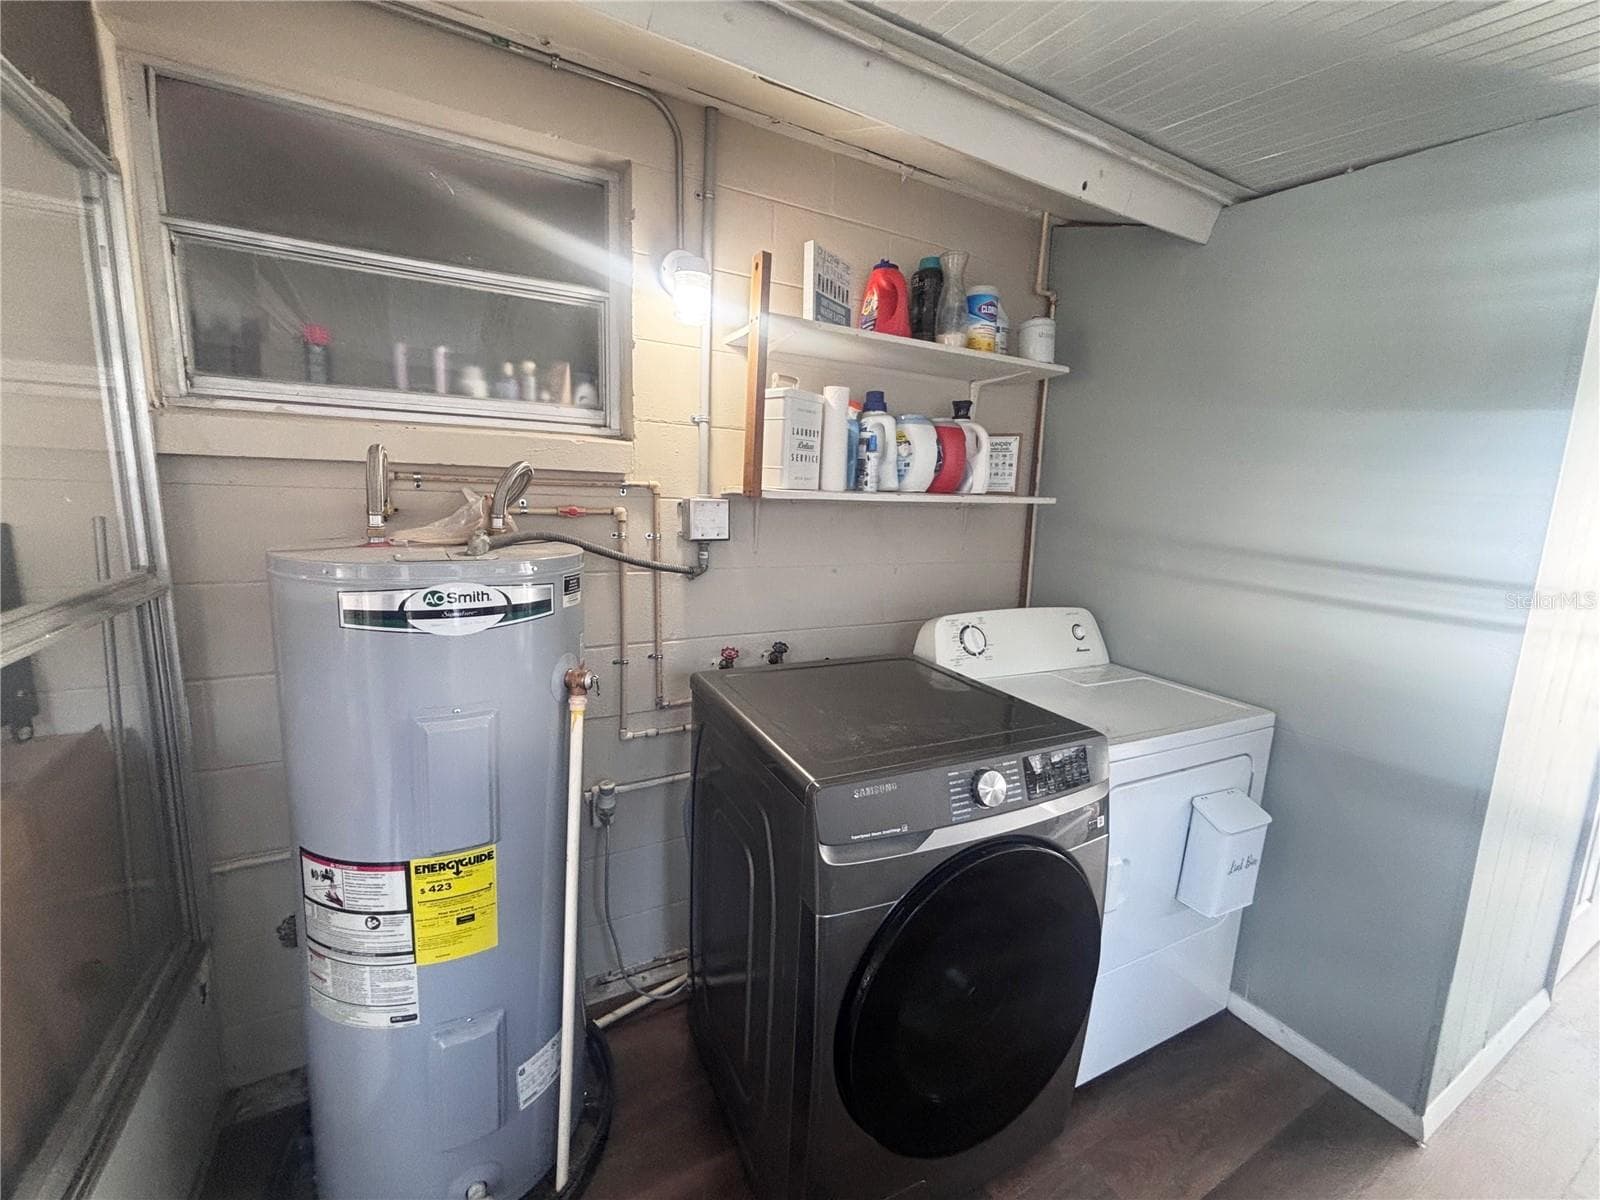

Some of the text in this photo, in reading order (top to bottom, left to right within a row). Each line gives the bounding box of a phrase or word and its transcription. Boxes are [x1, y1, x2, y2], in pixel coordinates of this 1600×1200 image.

[792, 427, 819, 437] LAUNDRY
[791, 453, 819, 463] SERVICE
[853, 783, 898, 799] SAMSUNG
[428, 882, 453, 893] 423
